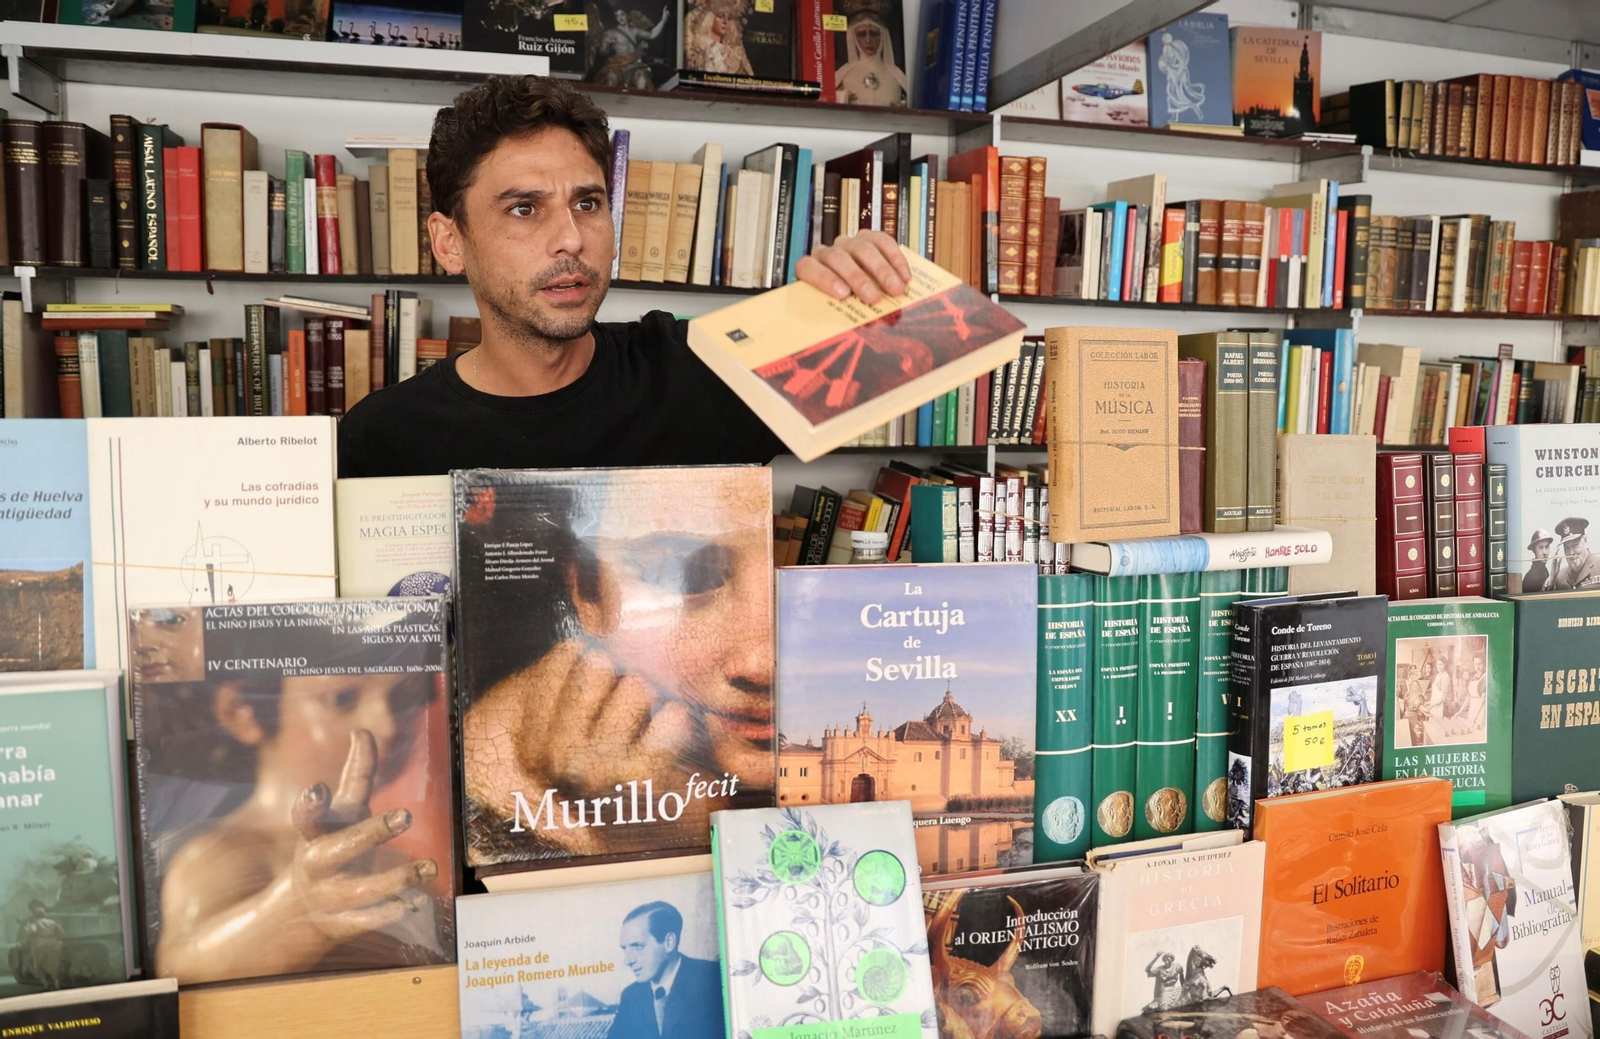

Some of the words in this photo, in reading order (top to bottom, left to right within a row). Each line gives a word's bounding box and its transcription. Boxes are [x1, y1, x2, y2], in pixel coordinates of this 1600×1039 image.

[1190, 20, 1215, 30] BIBLIA
[518, 34, 551, 45] Francisco
[552, 36, 576, 46] Antonio
[1243, 36, 1255, 46] LA
[1255, 37, 1301, 48] CATEDRAL
[518, 40, 542, 53] Ruiz
[545, 41, 576, 56] Gijón
[1266, 46, 1277, 55] DE
[1254, 55, 1289, 65] SEVILLA
[952, 52, 964, 93] SEVILLA
[978, 52, 991, 93] SEVILLA
[143, 133, 155, 167] MISAL
[144, 169, 156, 210] LATINO
[929, 206, 935, 217] DE
[146, 212, 158, 264] ESPAÑOL
[250, 317, 262, 378] TREASURES
[1257, 351, 1276, 359] MIGUEL
[1090, 351, 1133, 360] COLECCIÓN
[1134, 351, 1159, 361] LABOR
[1222, 358, 1245, 367] ALBERTI
[1224, 352, 1244, 360] RAFAEL
[1019, 355, 1032, 385] BAROJA
[1033, 355, 1046, 385] BAROJA
[252, 378, 262, 392] OF
[1103, 381, 1146, 390] HISTORIA
[1016, 384, 1028, 407] CARO
[1029, 385, 1041, 408] CARO
[1095, 398, 1155, 415] MÚSICA
[1012, 405, 1024, 430] JULIO
[1025, 406, 1038, 431] JULIO
[237, 436, 277, 446] Alberto
[280, 436, 318, 446] Ribelot
[1535, 446, 1599, 461] WINSTON
[1535, 464, 1600, 478] CHURCHI
[241, 482, 262, 492] Las
[265, 481, 320, 492] cofradías
[204, 498, 211, 508] y
[214, 498, 229, 506] su
[231, 496, 273, 506] mundo
[275, 495, 320, 508] jurídico
[372, 512, 447, 522] PRESTIDIGITADOR
[903, 582, 923, 596] La
[206, 606, 244, 619] ACTAS
[247, 605, 269, 617] DEL
[271, 603, 340, 617] COLOQUIO
[342, 601, 441, 614] INTERNACIONAL
[206, 621, 218, 630] EL
[220, 618, 247, 629] NIÑO
[249, 617, 274, 629] JESÚS
[275, 618, 282, 627] Y
[284, 618, 295, 627] LA
[297, 616, 343, 627] INFANCIA
[859, 602, 966, 635] Cartuja
[1048, 620, 1085, 630] HISTORIA
[1104, 618, 1138, 628] HISTORIA
[1153, 616, 1189, 625] HISTORIA
[1045, 631, 1057, 640] DE
[1059, 628, 1086, 640] ESPAÑA
[1150, 626, 1162, 635] DE
[1164, 624, 1191, 634] ESPAÑA
[1234, 623, 1251, 633] Conde
[1271, 625, 1296, 636] Conde
[1296, 624, 1307, 634] de
[1307, 622, 1333, 633] Toreno
[361, 634, 393, 645] SIGLOS
[395, 634, 408, 644] XV
[408, 634, 421, 643] AL
[422, 633, 442, 643] XVII
[903, 636, 922, 649] de
[1233, 634, 1251, 644] Toreno
[1271, 643, 1300, 653] HISTORIA
[1300, 641, 1312, 650] DEL
[1313, 636, 1362, 648] LEVANTAMIENTO
[1271, 652, 1296, 662] GUERRA
[1296, 651, 1302, 660] Y
[1302, 647, 1340, 658] REVOLUCIÓN
[208, 659, 222, 671] IV
[224, 657, 308, 670] CENTENARIO
[282, 668, 295, 676] DEL
[297, 667, 322, 676] NIÑO
[324, 665, 345, 675] JESÚS
[346, 666, 362, 674] DEL
[405, 664, 443, 673] 1606-2006
[865, 655, 958, 682] Sevilla
[1270, 663, 1280, 672] DE
[1281, 660, 1305, 670] ESPAÑA
[1055, 709, 1078, 723] XX
[1292, 724, 1300, 736] 5
[1302, 721, 1327, 732] tomos
[1395, 756, 1419, 768] LAS
[1424, 751, 1487, 766] MUJERES
[1395, 768, 1410, 780] EN
[1413, 766, 1428, 778] LA
[1432, 764, 1486, 777] HISTORIA
[509, 778, 687, 833] Murillo
[682, 772, 740, 808] fecit
[1328, 830, 1354, 843] Camilo
[1354, 826, 1371, 840] José
[1371, 823, 1389, 835] Cela
[1139, 861, 1235, 886] HISTORIA
[1312, 883, 1330, 906] El
[1333, 871, 1401, 901] Solitario
[1523, 879, 1569, 908] Manual
[1148, 894, 1223, 917] GRECIA
[1546, 902, 1559, 916] de
[1005, 907, 1079, 928] Introducción
[1325, 918, 1370, 936] Ilustraciones
[1369, 914, 1379, 925] de
[954, 932, 966, 946] al
[968, 920, 1080, 945] ORIENTALISMO
[1510, 911, 1573, 942] Bibliografía
[464, 937, 503, 950] Joaquín
[504, 934, 537, 945] Arbide
[1015, 933, 1080, 954] ANTIGUO
[465, 958, 481, 971] La
[482, 952, 533, 972] leyenda
[534, 951, 550, 964] de
[1024, 963, 1049, 972] Wolfram
[1049, 961, 1060, 969] von
[1061, 959, 1079, 968] Soden
[465, 970, 516, 989] Joaquín
[517, 967, 565, 983] Romero
[567, 960, 616, 977] Murube
[1325, 990, 1403, 1016] Azaña
[1337, 1016, 1354, 1029] y
[1353, 997, 1438, 1022] Cataluña
[1, 1022, 45, 1039] ENRIQUE
[47, 1015, 103, 1031] VALDIVIESO
[1542, 1021, 1570, 1036] CASTALIA
